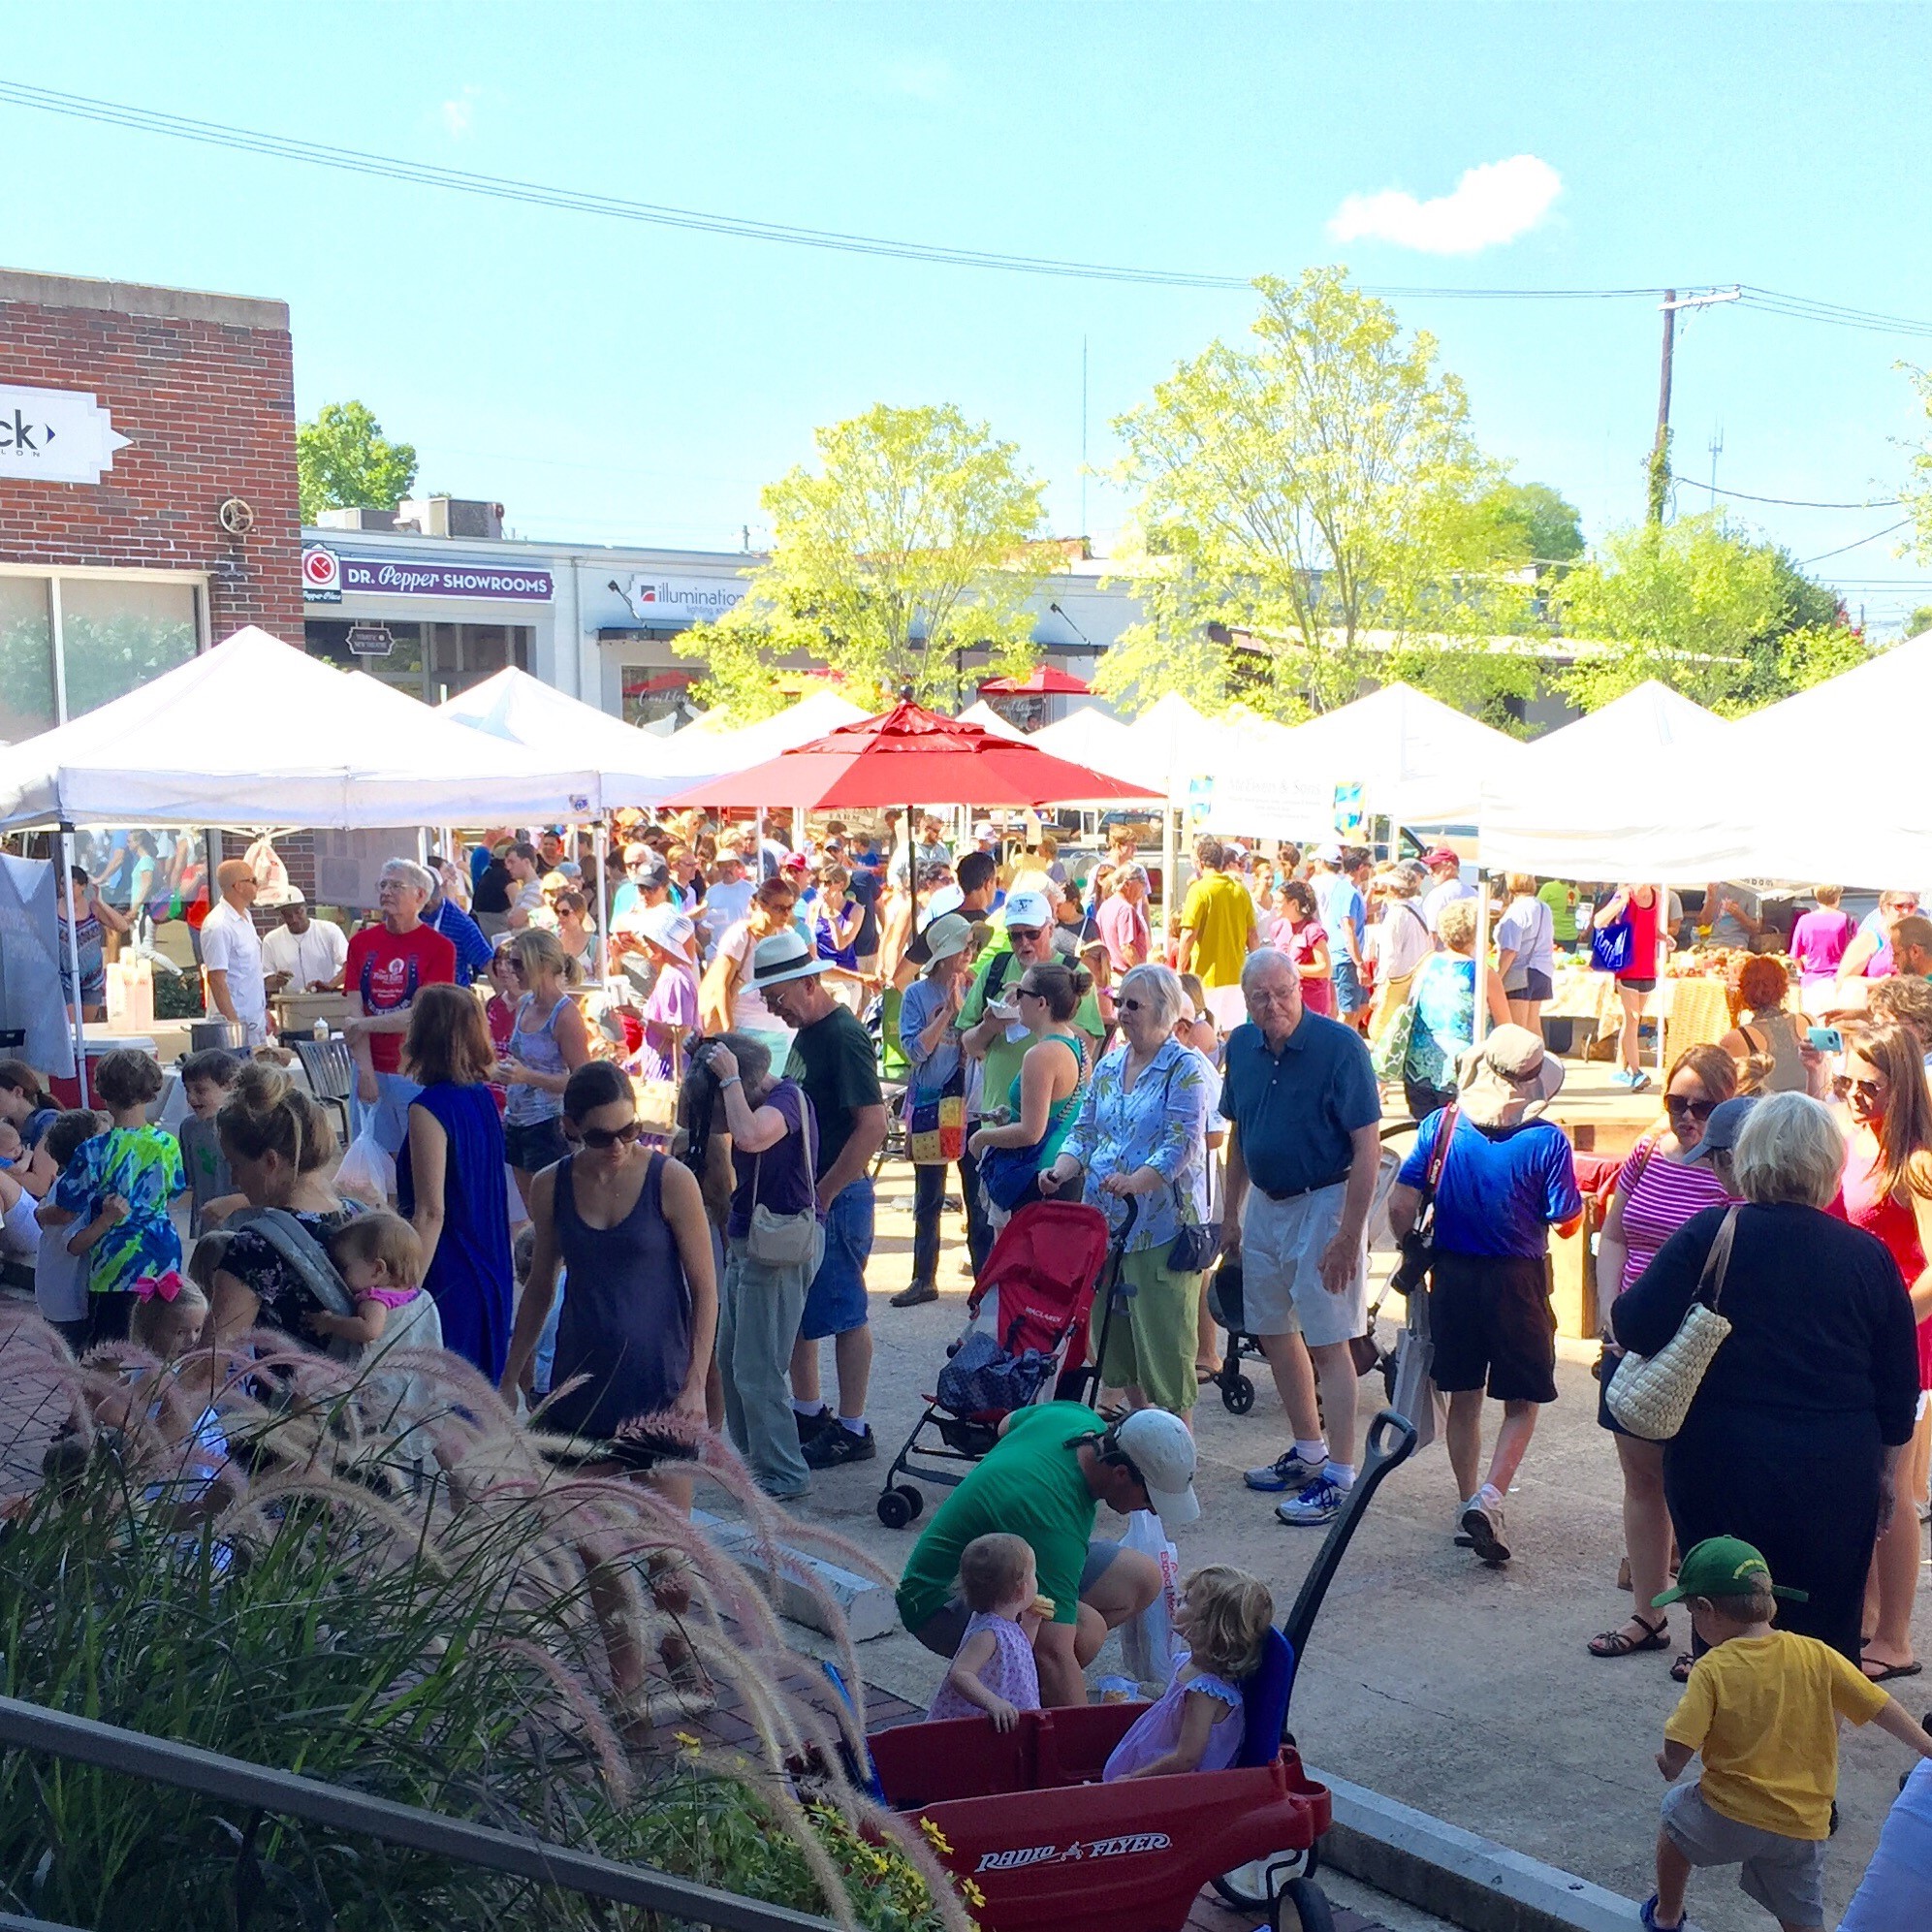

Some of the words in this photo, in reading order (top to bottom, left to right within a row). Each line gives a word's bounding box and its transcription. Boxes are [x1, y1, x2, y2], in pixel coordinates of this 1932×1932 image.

[348, 568, 376, 585] DR.
[378, 565, 440, 591] Pepper
[443, 574, 548, 593] SHOWROOMS
[974, 1845, 1057, 1873] RADIO
[1090, 1833, 1171, 1858] FLYER
